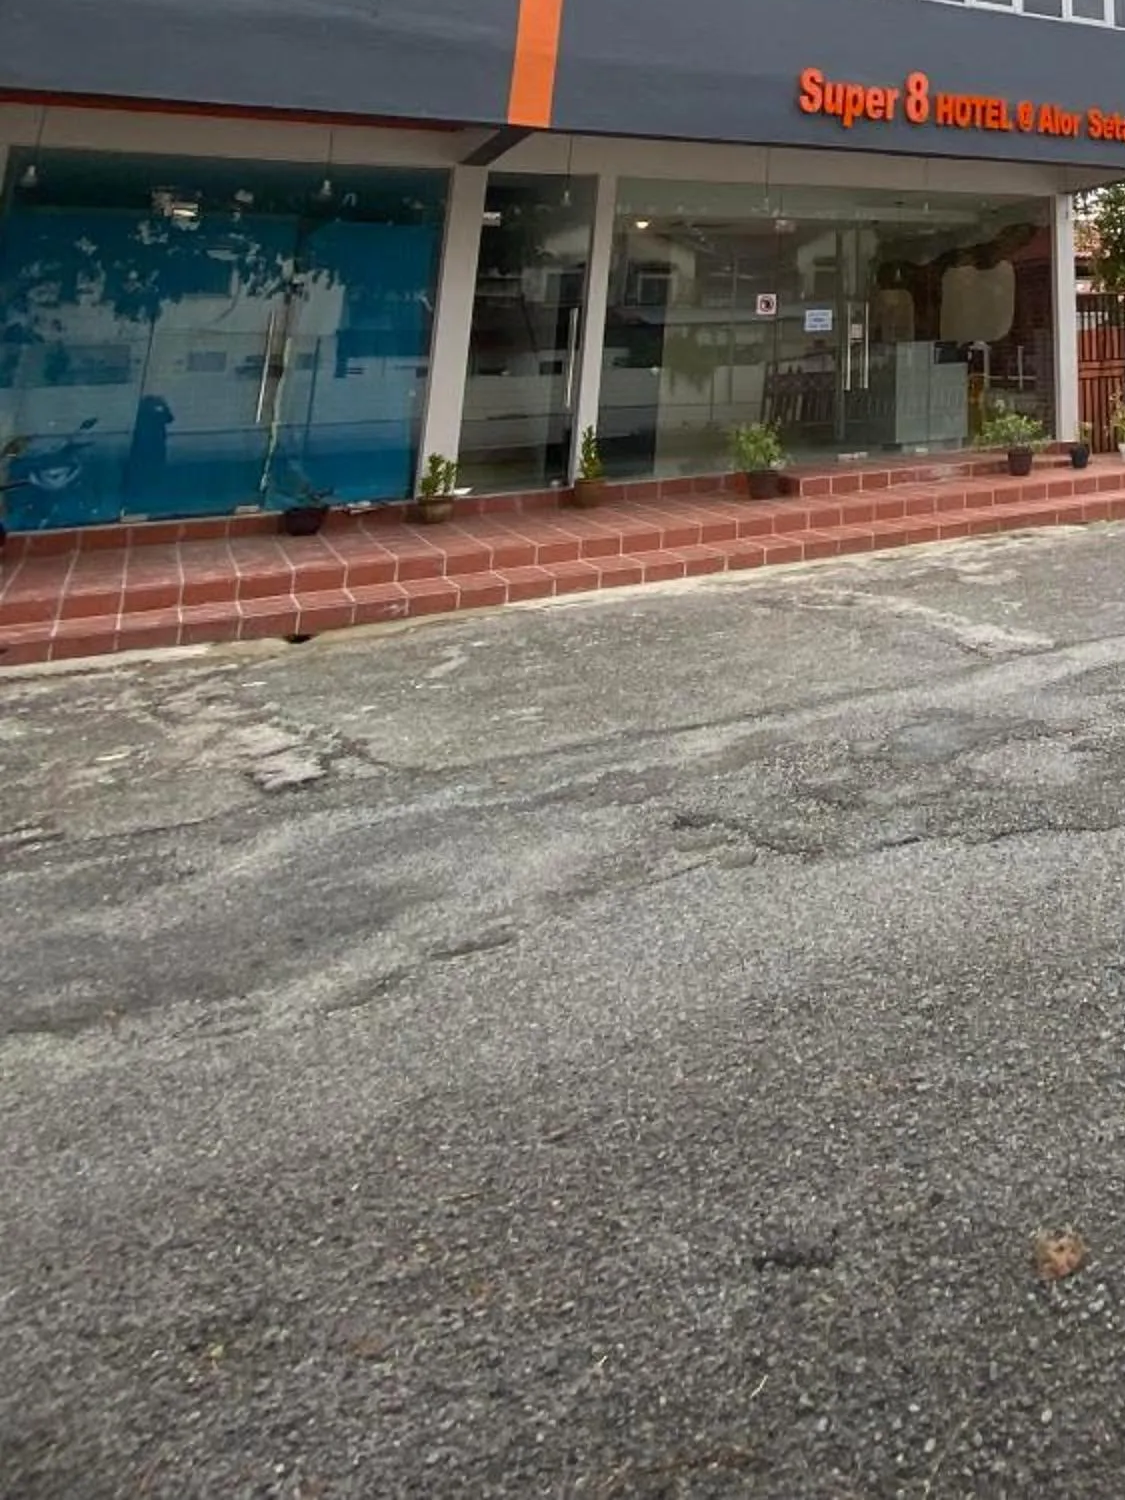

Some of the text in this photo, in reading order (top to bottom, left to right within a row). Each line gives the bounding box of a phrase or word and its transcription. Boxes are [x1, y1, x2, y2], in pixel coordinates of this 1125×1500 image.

[799, 67, 898, 128] Super
[904, 72, 930, 124] 8
[936, 92, 1012, 132] HOTEL
[1038, 104, 1081, 137] Alor
